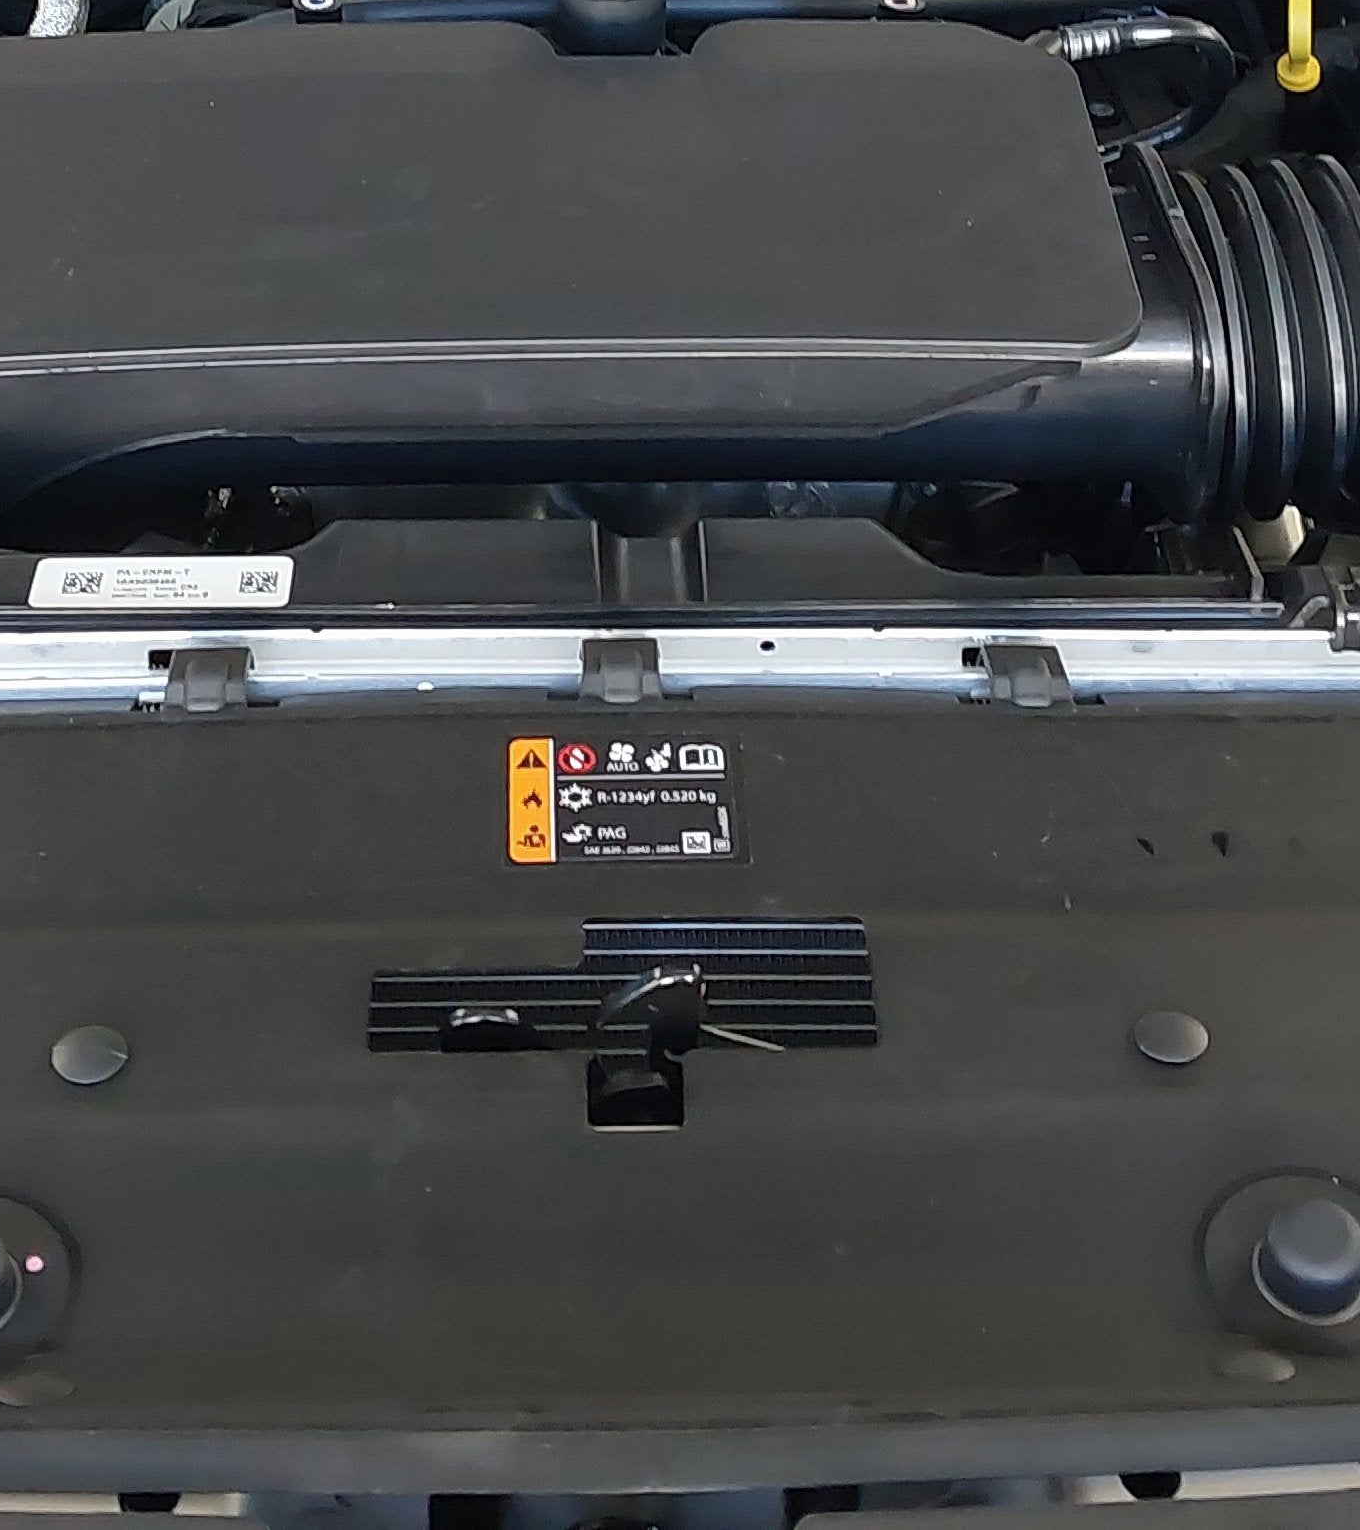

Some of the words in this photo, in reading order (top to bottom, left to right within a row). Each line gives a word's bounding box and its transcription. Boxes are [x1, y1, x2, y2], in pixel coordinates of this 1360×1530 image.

[606, 762, 640, 773] AUTO
[597, 789, 656, 805] R-1234yf
[699, 789, 717, 805] kg
[597, 826, 627, 840] PAG
